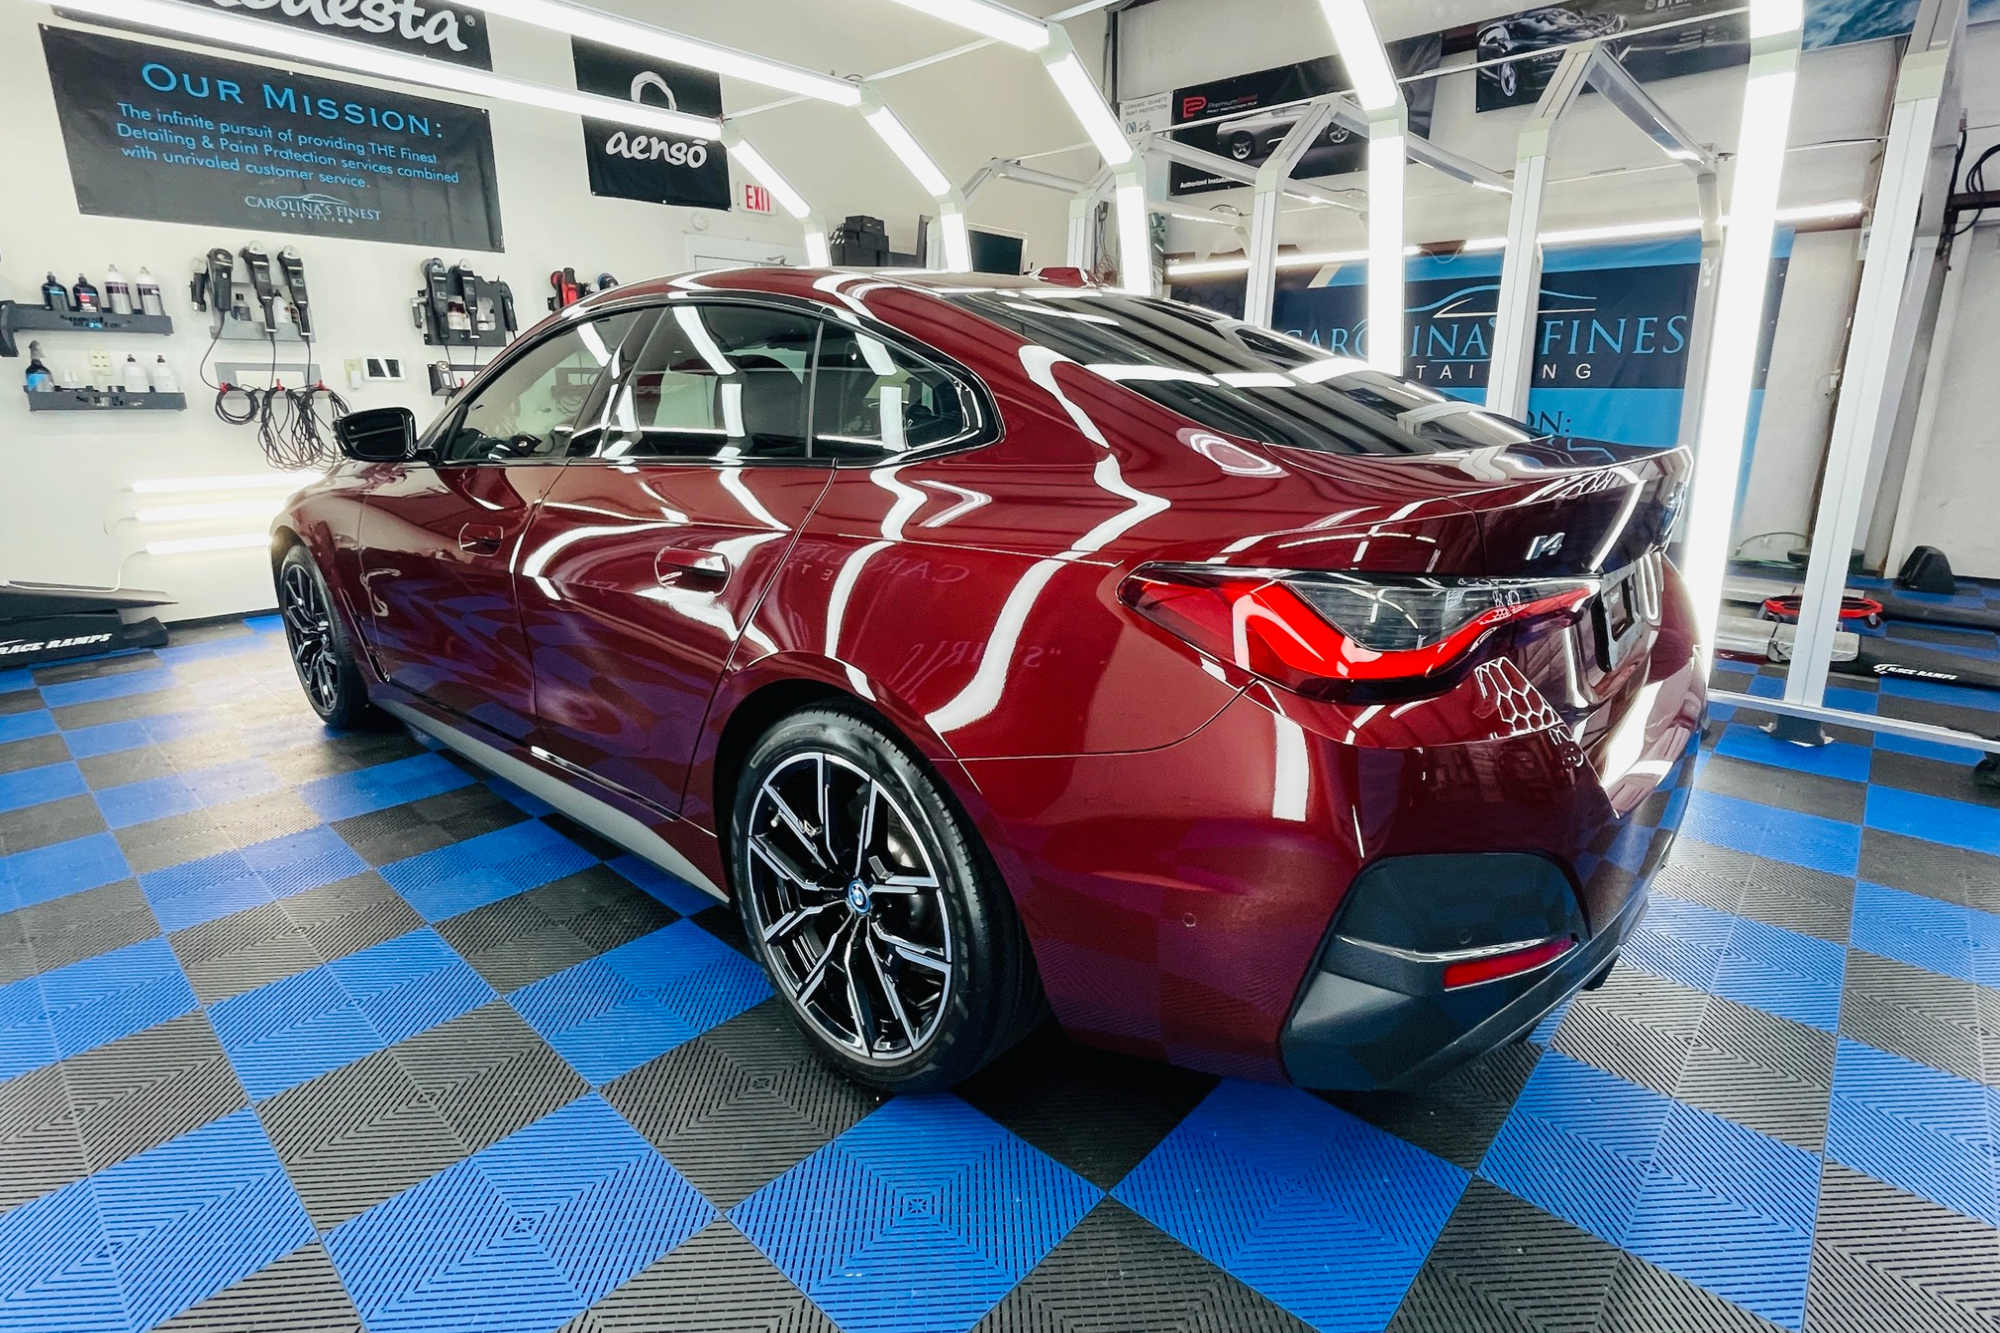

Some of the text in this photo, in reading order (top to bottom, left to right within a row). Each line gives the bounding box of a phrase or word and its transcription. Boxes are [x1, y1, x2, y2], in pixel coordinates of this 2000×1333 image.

[141, 63, 443, 138] OUR MISSION:
[116, 102, 438, 164] The infinite pursuit of providing THE Finest
[116, 122, 459, 184] Detailing & Paint Protection services combined
[121, 144, 371, 188] with unrivaled customer service.
[244, 195, 382, 221] CAROLINA'S FINEST
[1541, 315, 1687, 355] FINES
[46, 633, 113, 649] RAMPS
[1917, 670, 1958, 680] RAMPS
